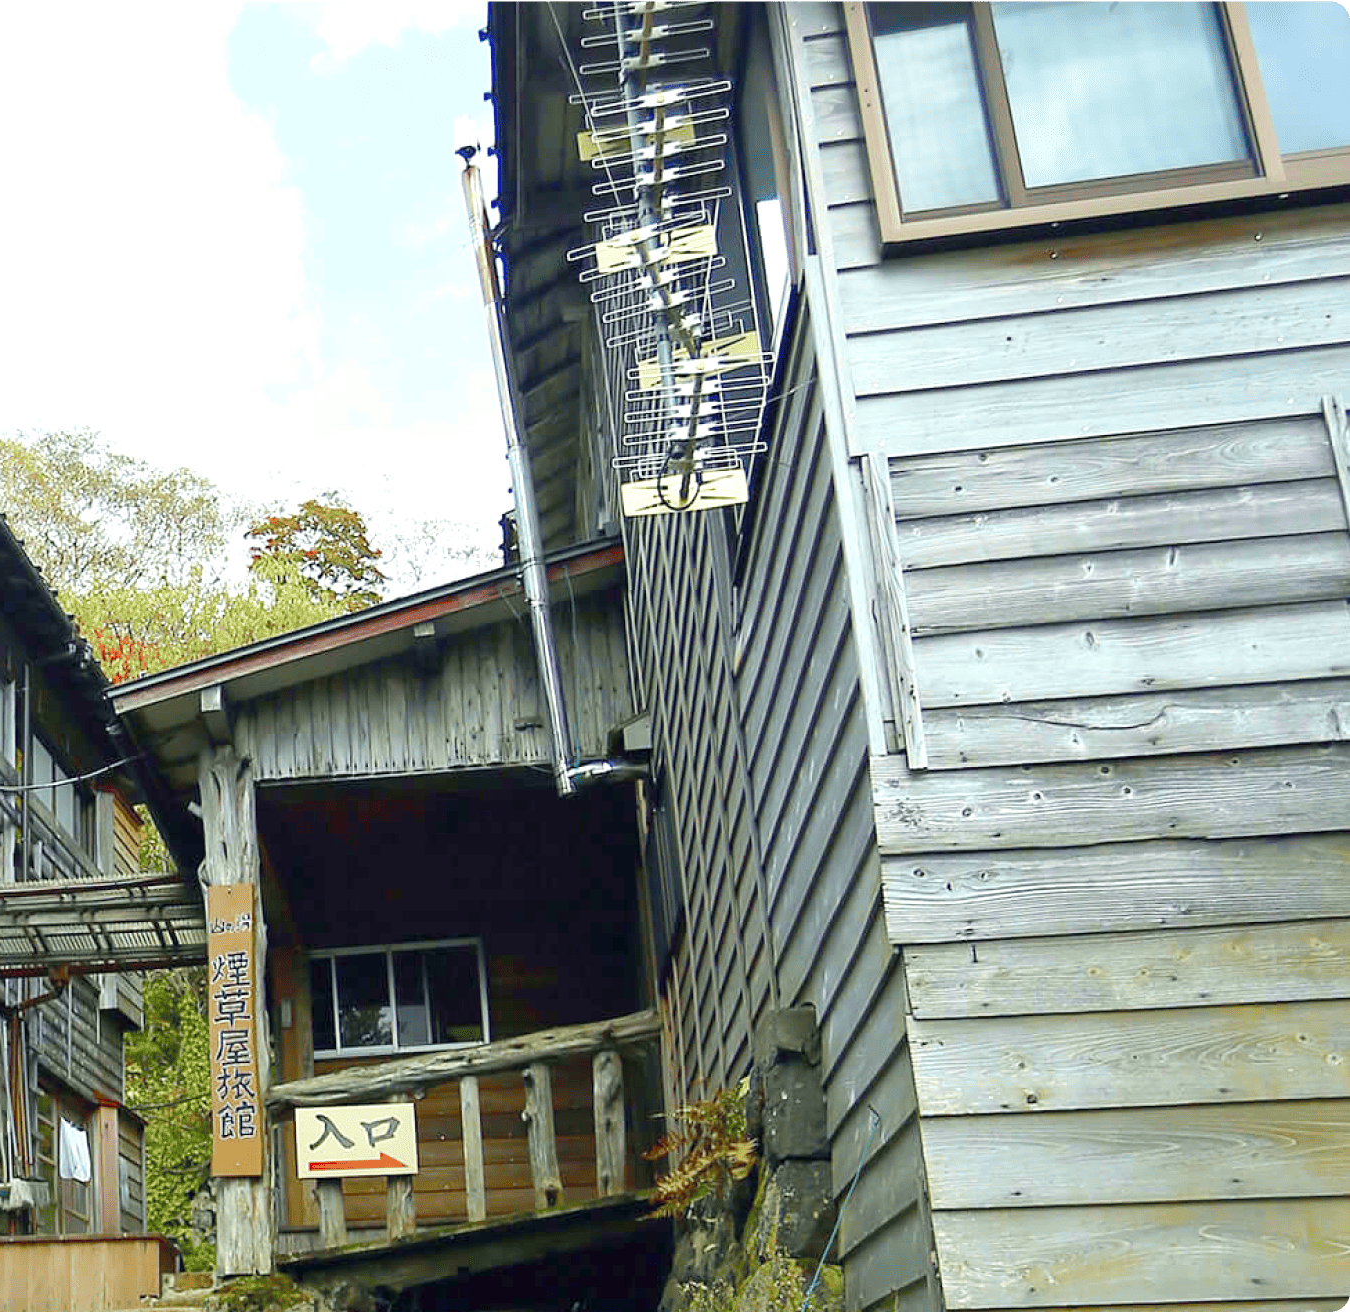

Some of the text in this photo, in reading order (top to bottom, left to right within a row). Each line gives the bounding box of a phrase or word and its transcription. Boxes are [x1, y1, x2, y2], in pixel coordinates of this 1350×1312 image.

[211, 950, 256, 1139] 煙草屋旅館
[309, 1113, 401, 1149] 入口
